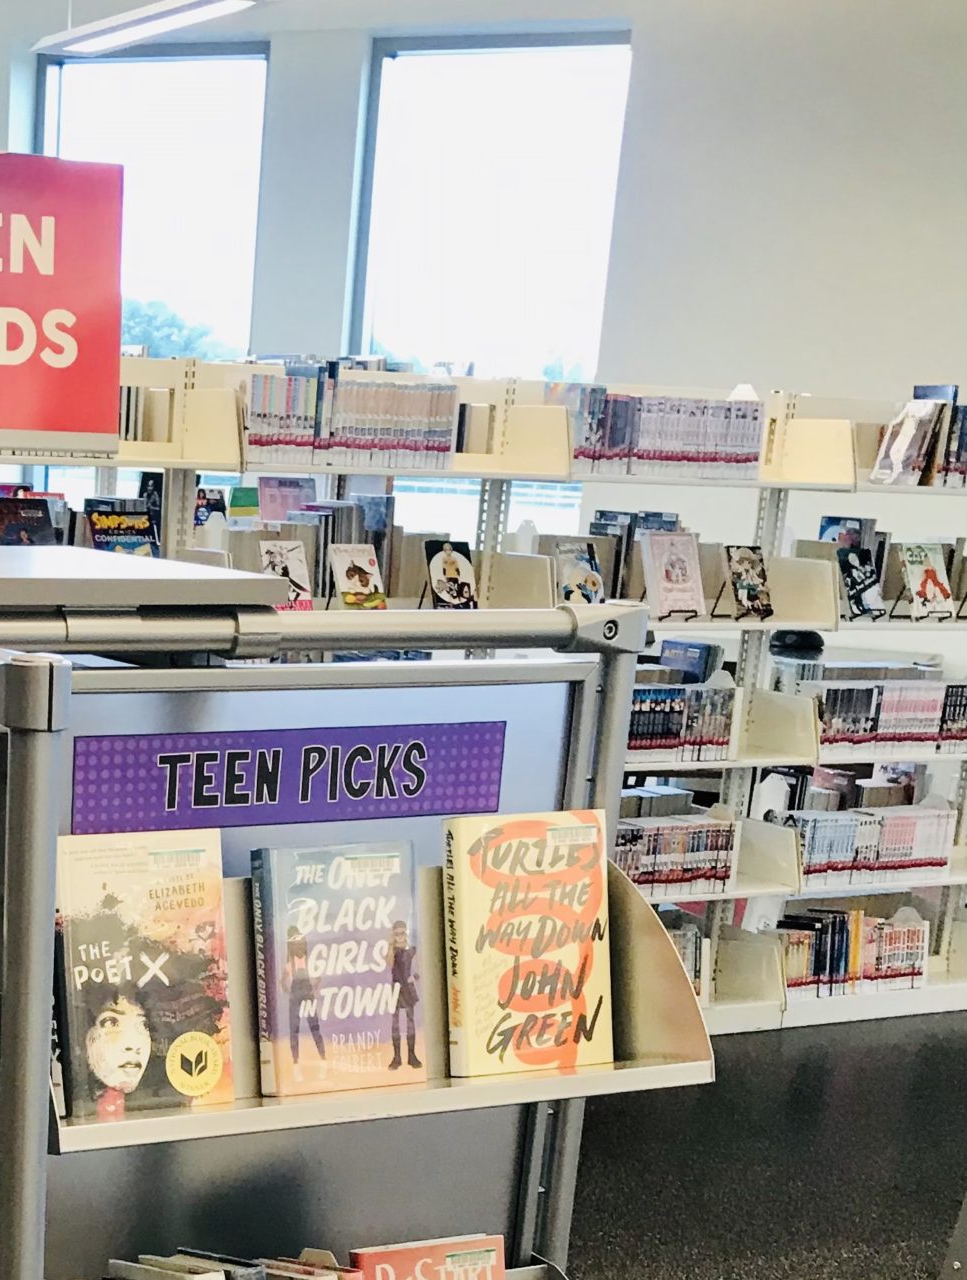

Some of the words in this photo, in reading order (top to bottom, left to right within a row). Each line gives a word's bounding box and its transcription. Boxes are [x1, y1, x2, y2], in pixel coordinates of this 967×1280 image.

[91, 512, 151, 530] SIMPSONS
[94, 533, 156, 543] CONFIDENTIAL
[157, 748, 283, 812] TEEN
[299, 740, 429, 803] PICKS
[149, 882, 205, 900] ELIZABETH
[295, 864, 326, 885] THE
[155, 897, 205, 911] ACEVEDO
[287, 895, 397, 935] BLACK
[489, 879, 537, 917] ALL
[544, 880, 594, 912] THE
[78, 940, 112, 962] THE
[475, 916, 532, 954] WAY
[531, 915, 607, 960] DOWN
[137, 951, 170, 988] X
[308, 940, 389, 978] GIRLS
[497, 954, 589, 1011] JOHN
[299, 998, 317, 1018] IN
[319, 982, 402, 1021] TOWN
[331, 1030, 382, 1052] BRANDY
[485, 994, 605, 1064] GREEN
